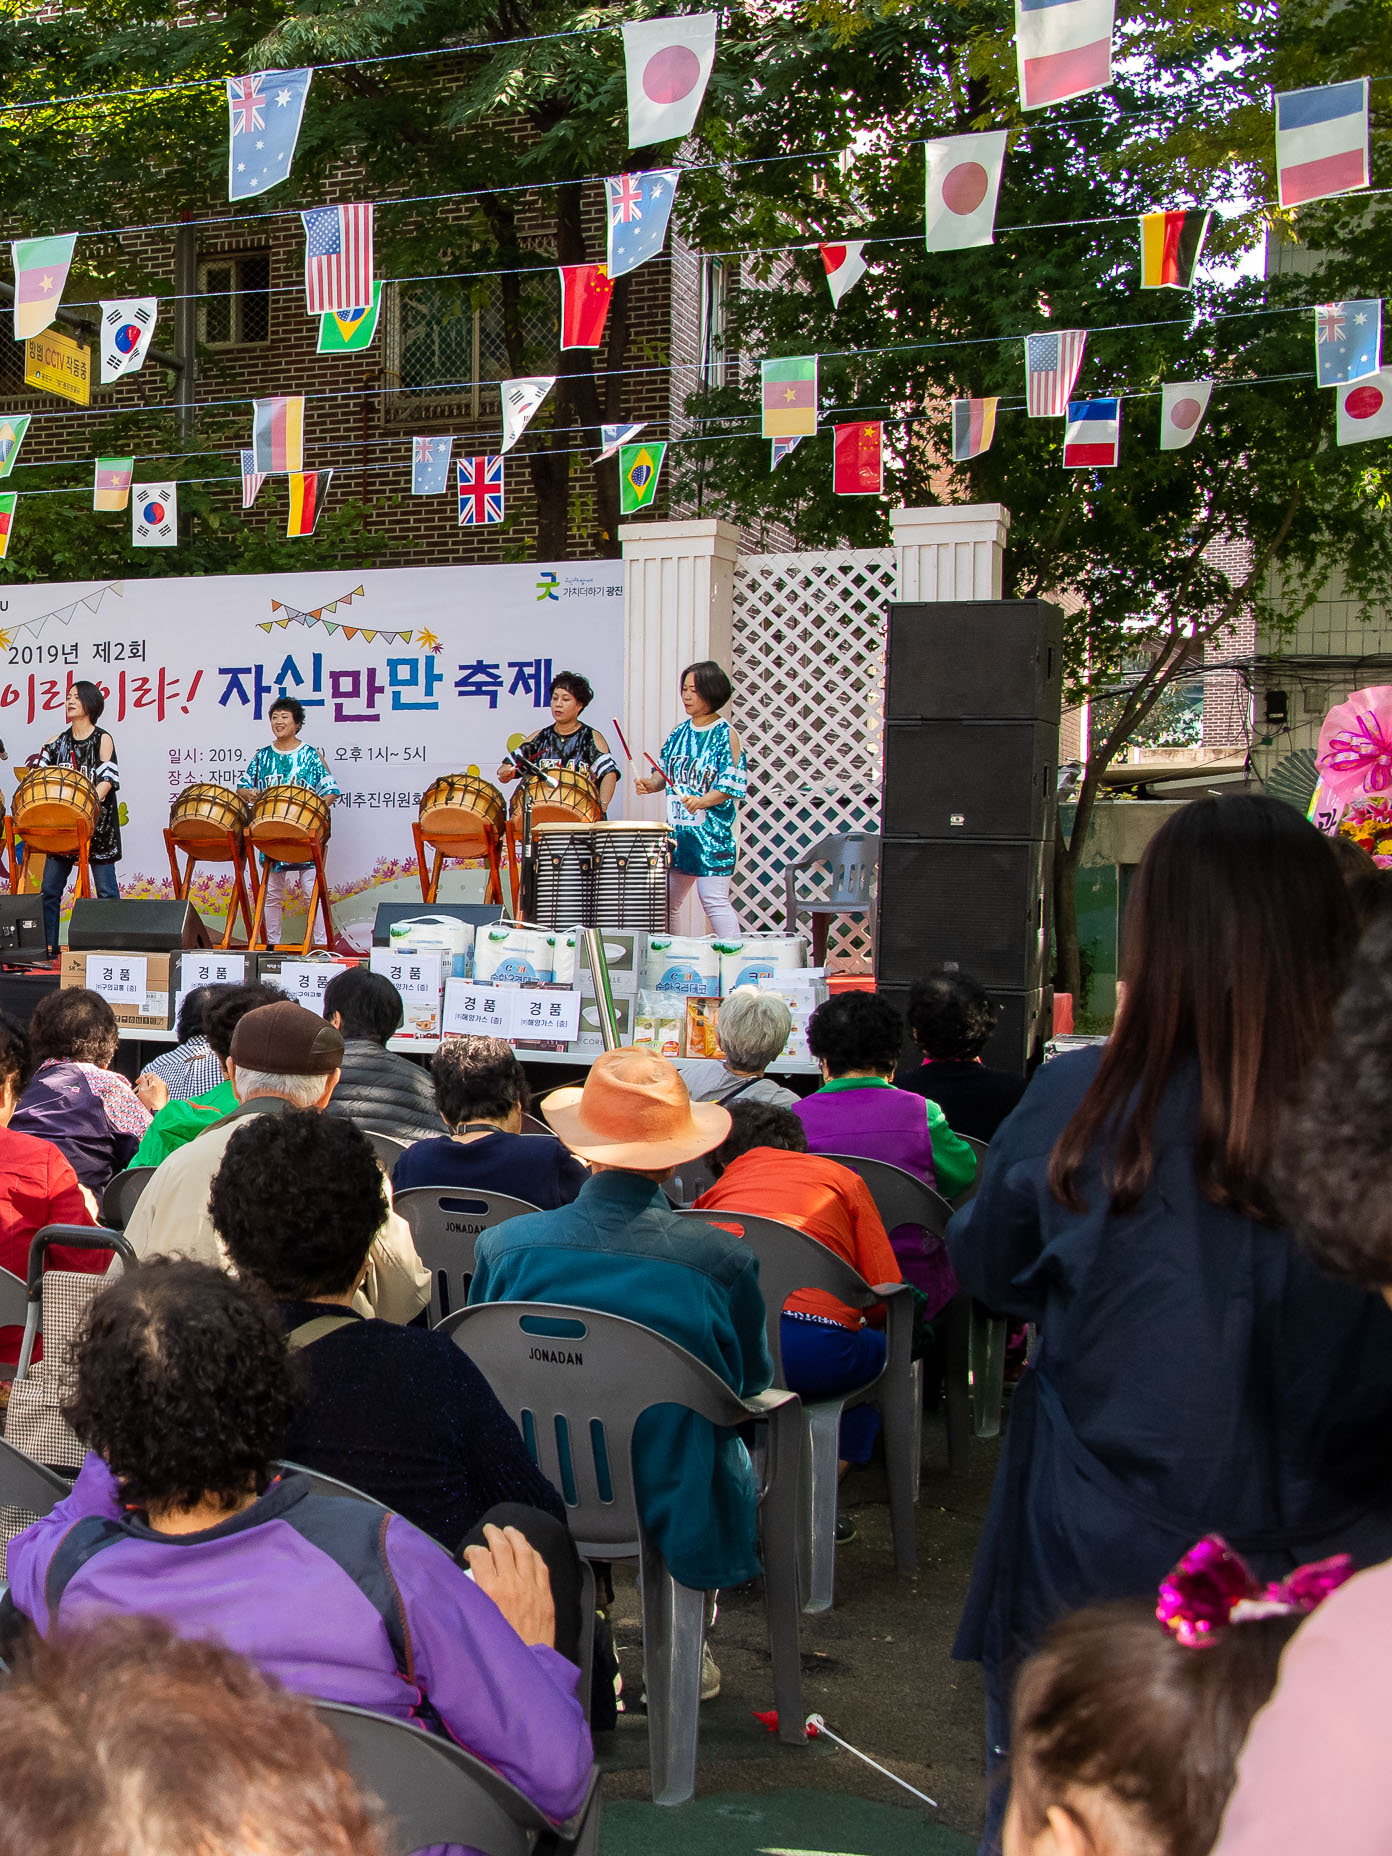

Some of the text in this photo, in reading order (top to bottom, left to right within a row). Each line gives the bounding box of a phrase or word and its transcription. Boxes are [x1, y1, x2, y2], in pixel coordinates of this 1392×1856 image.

[45, 347, 65, 371] CCTV
[606, 586, 623, 597] 광진
[8, 639, 146, 665] 2019년 제2회
[218, 652, 444, 722] 자신만만
[454, 658, 552, 708] 축제
[209, 748, 247, 762] 2019.
[334, 747, 363, 763] 오후
[331, 791, 422, 809] 제추진위원회
[102, 968, 130, 981] 경 품
[198, 966, 227, 979] 경 품
[390, 966, 421, 980] 경 품
[298, 975, 328, 988] 경 품
[587, 976, 622, 984] CLLE
[464, 996, 496, 1013] 경 품
[530, 1002, 562, 1016] 경 품
[583, 1038, 604, 1046] CORE
[529, 1347, 584, 1366] JONADAN
